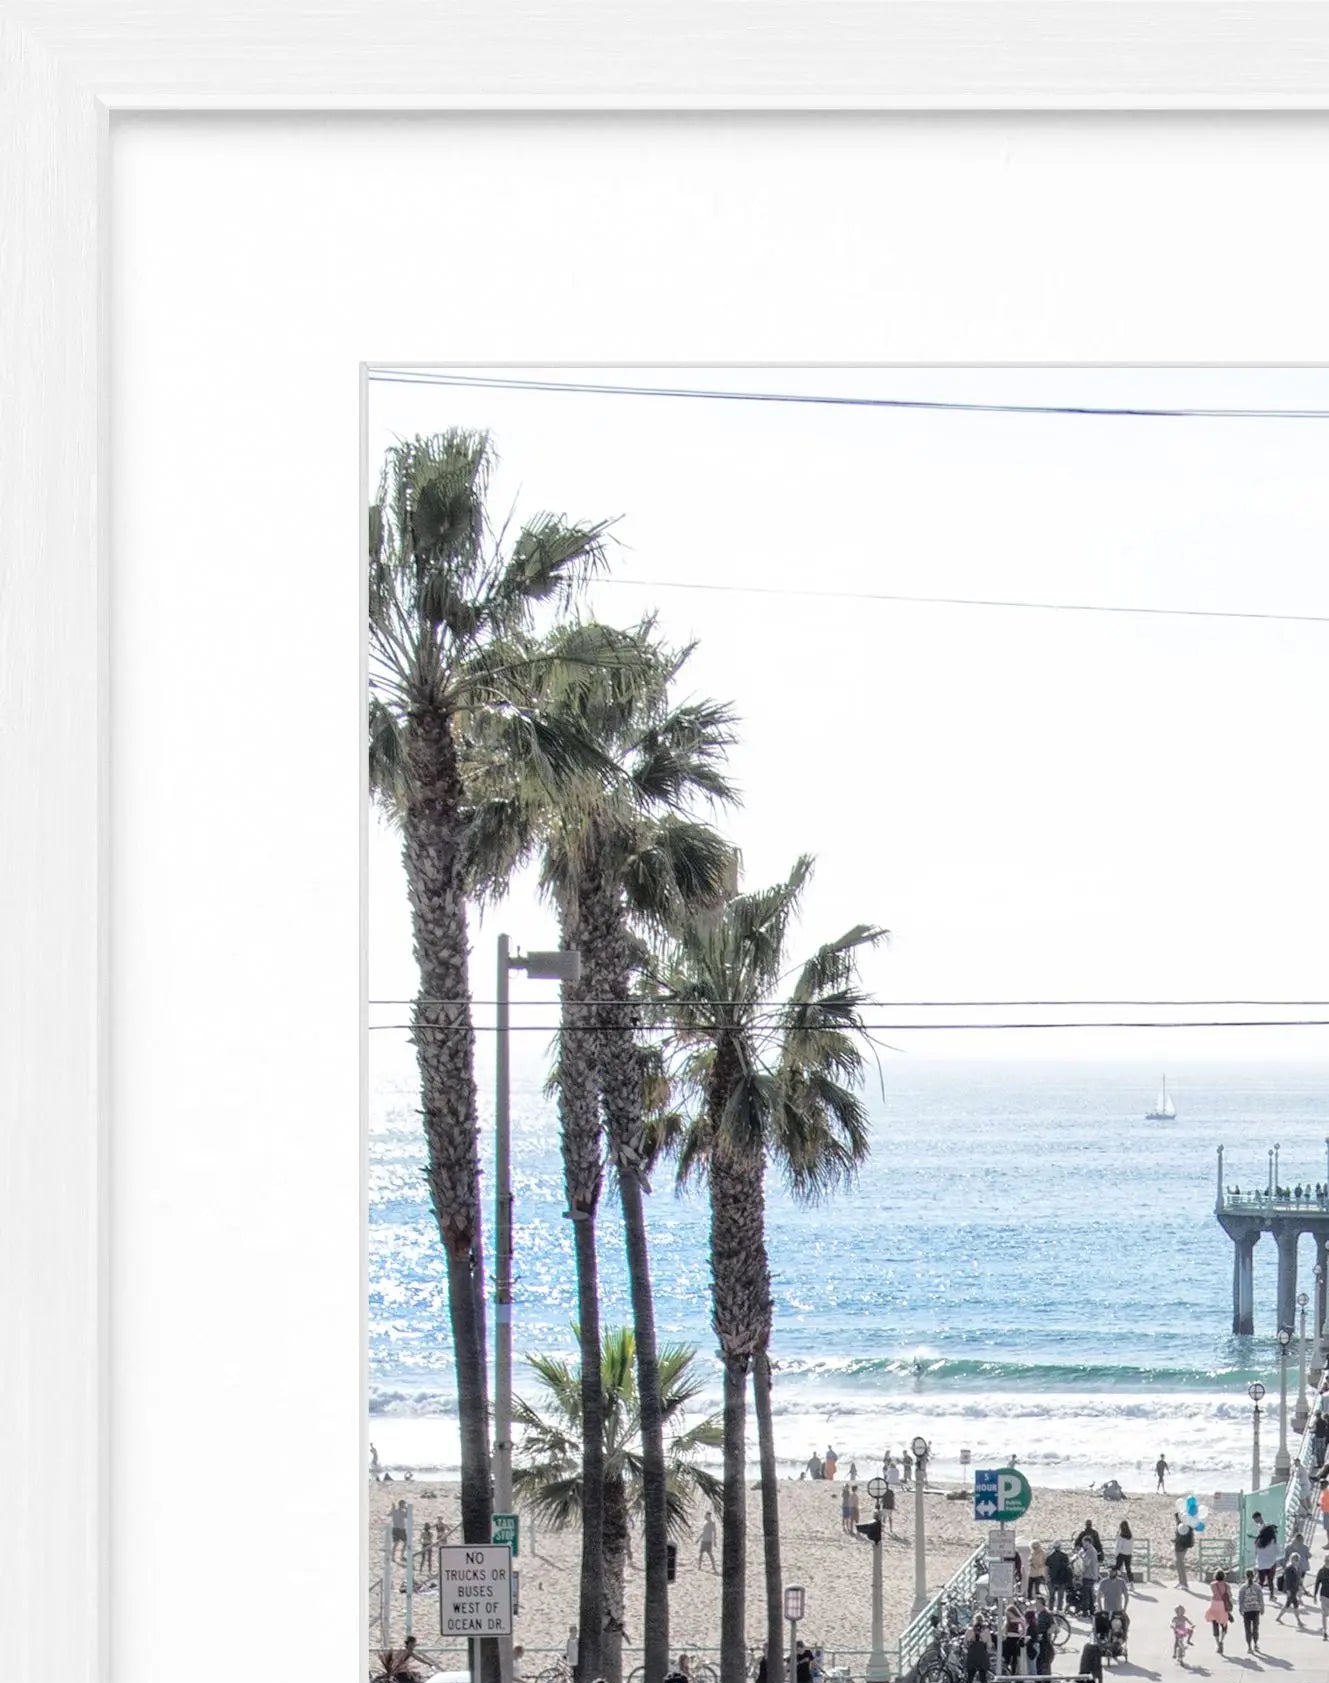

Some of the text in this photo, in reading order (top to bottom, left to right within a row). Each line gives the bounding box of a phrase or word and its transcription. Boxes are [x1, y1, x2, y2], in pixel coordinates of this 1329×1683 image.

[998, 1474, 1021, 1511] P
[495, 1529, 514, 1540] STOP
[466, 1552, 484, 1564] NO
[445, 1569, 506, 1581] TRUCKS OR
[458, 1585, 493, 1597] BUSES
[453, 1602, 499, 1614] WEST OF
[447, 1618, 505, 1630] OCEAN DR.
